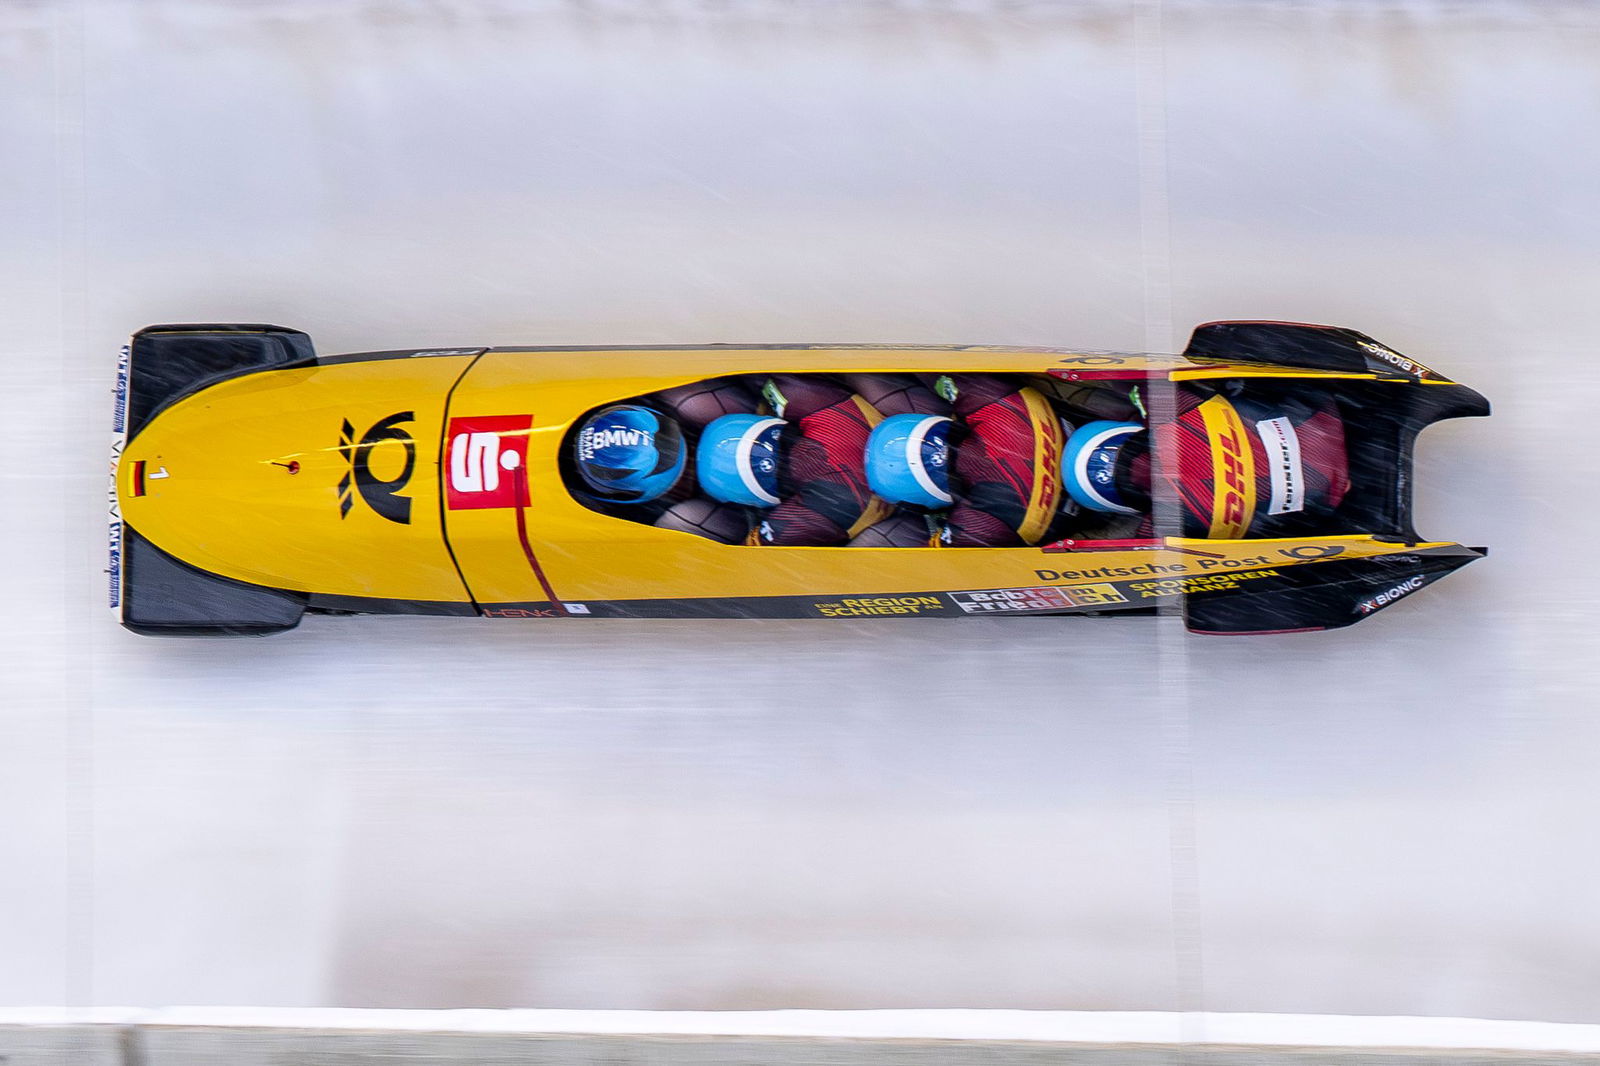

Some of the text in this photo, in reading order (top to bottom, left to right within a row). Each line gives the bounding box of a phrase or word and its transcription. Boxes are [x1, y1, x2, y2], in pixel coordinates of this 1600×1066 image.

[593, 429, 639, 450] BMW
[148, 466, 170, 480] 1
[1038, 417, 1057, 509] DHL
[1218, 427, 1246, 526] DHL
[1035, 555, 1270, 581] Deutsche Post
[1128, 570, 1280, 591] SPONSOREN
[1141, 582, 1240, 598] ALLIANZ
[842, 596, 942, 608] REGION
[1375, 578, 1423, 606] BIONIC
[819, 605, 921, 617] SCHIEBT
